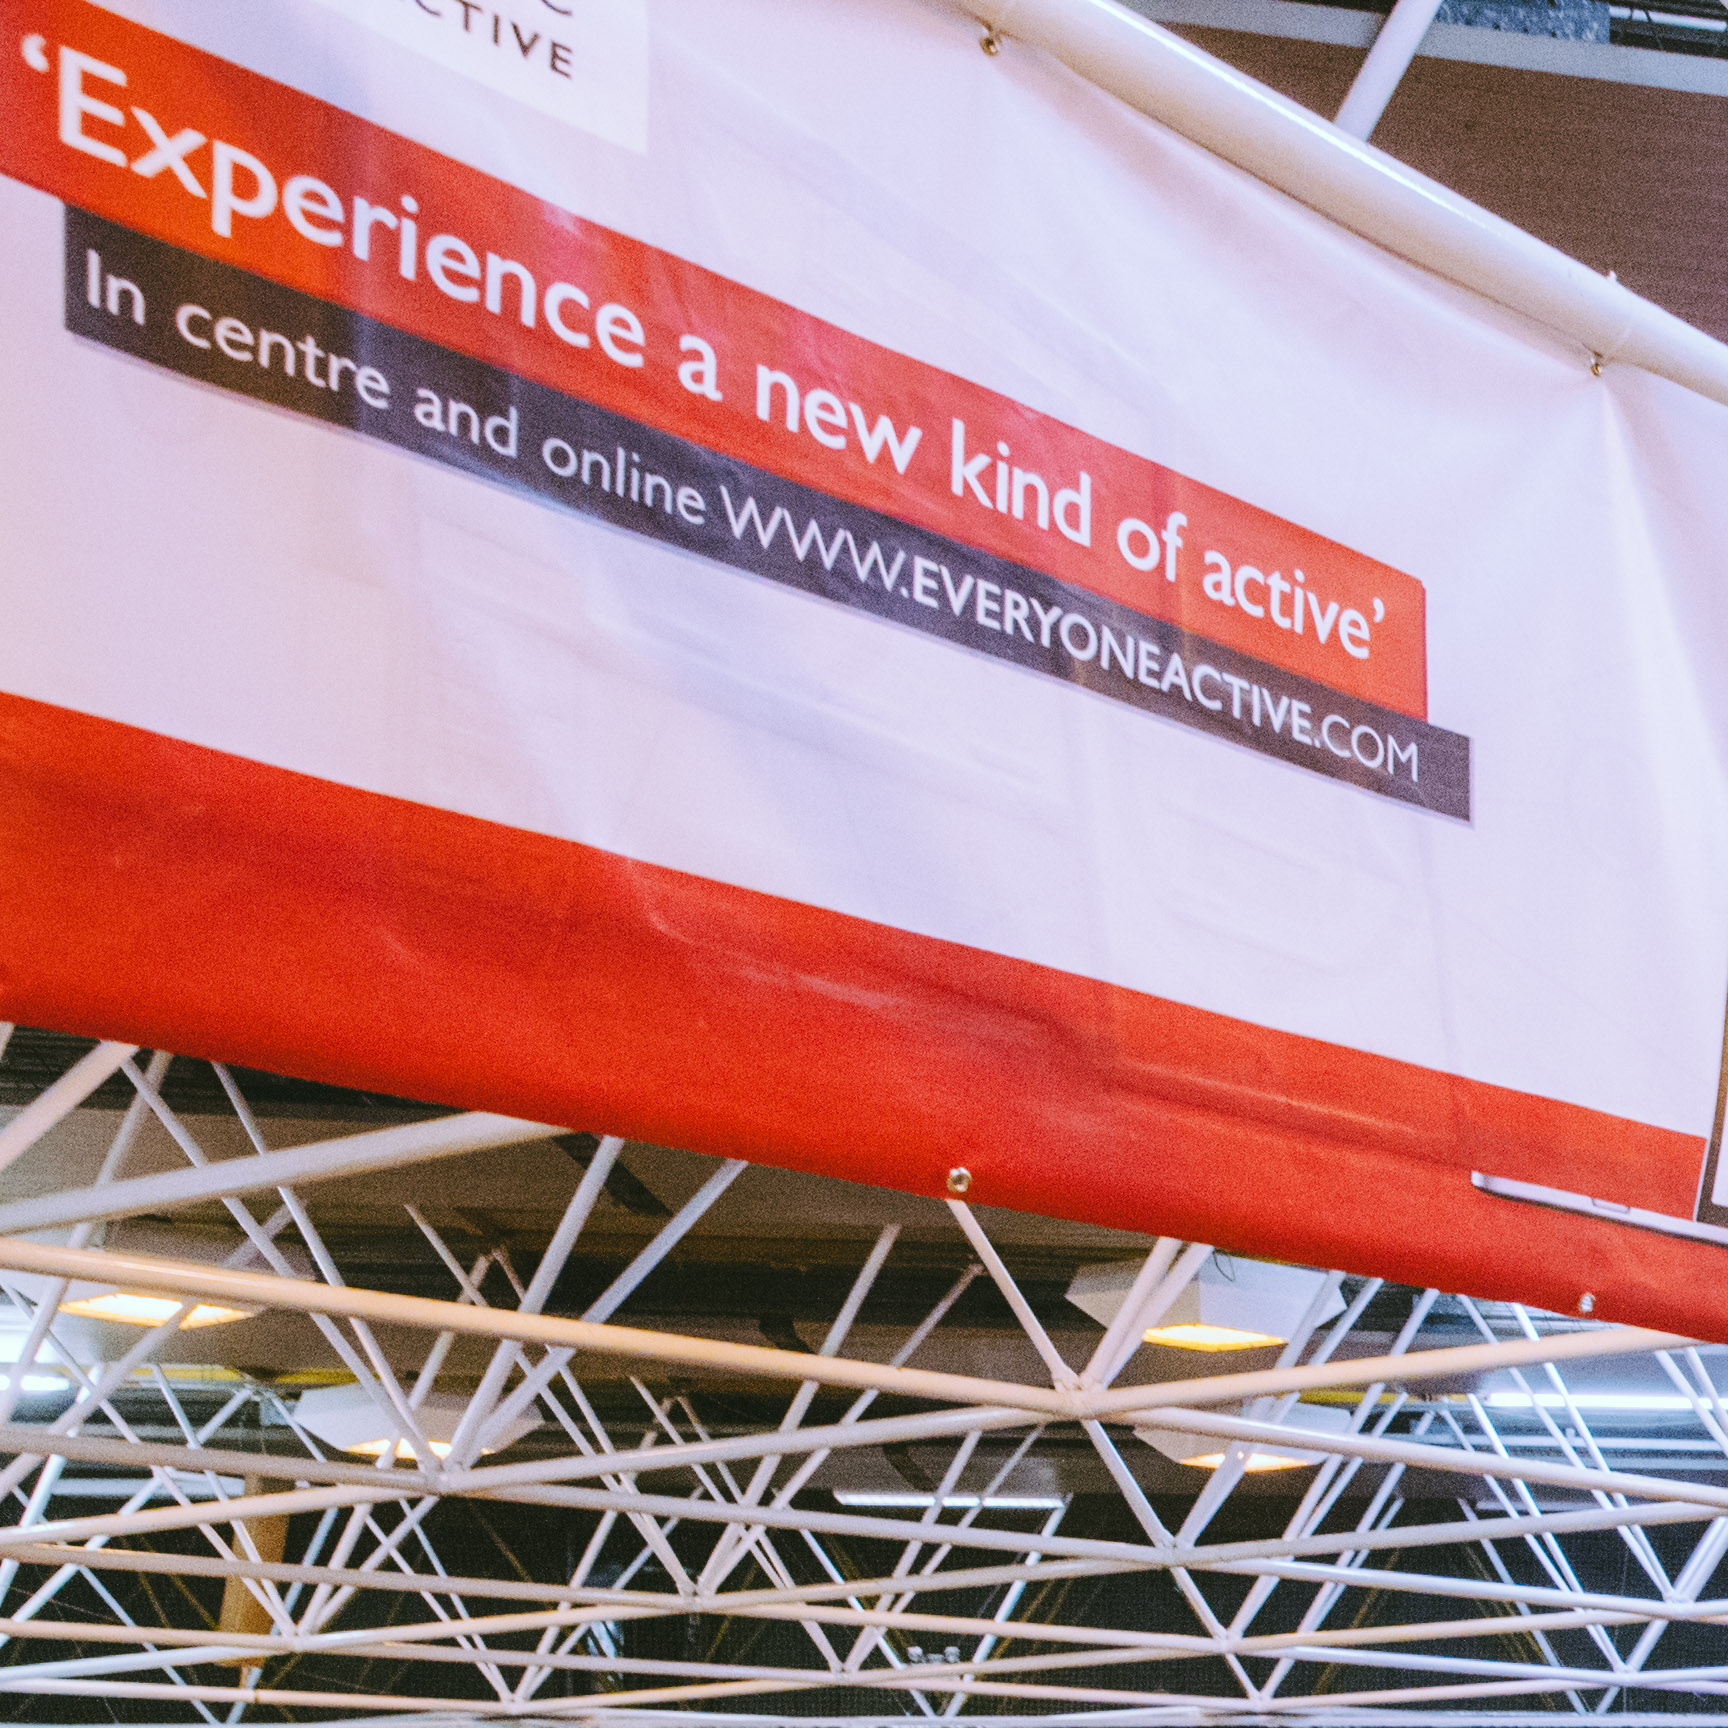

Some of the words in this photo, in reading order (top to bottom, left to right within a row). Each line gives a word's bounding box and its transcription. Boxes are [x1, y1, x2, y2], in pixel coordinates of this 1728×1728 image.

[413, 0, 572, 79] TIVE
[21, 33, 644, 370] ‘Experience
[679, 332, 722, 401] a
[756, 363, 924, 474] new
[952, 418, 1091, 548] kind
[1117, 512, 1187, 583] of
[1203, 548, 1384, 661] active’
[86, 249, 147, 325] In
[175, 302, 391, 410] centre
[413, 386, 520, 459] and
[541, 434, 707, 526] online
[720, 483, 1419, 784] WWW.EVERYONEACTIVE.COM
